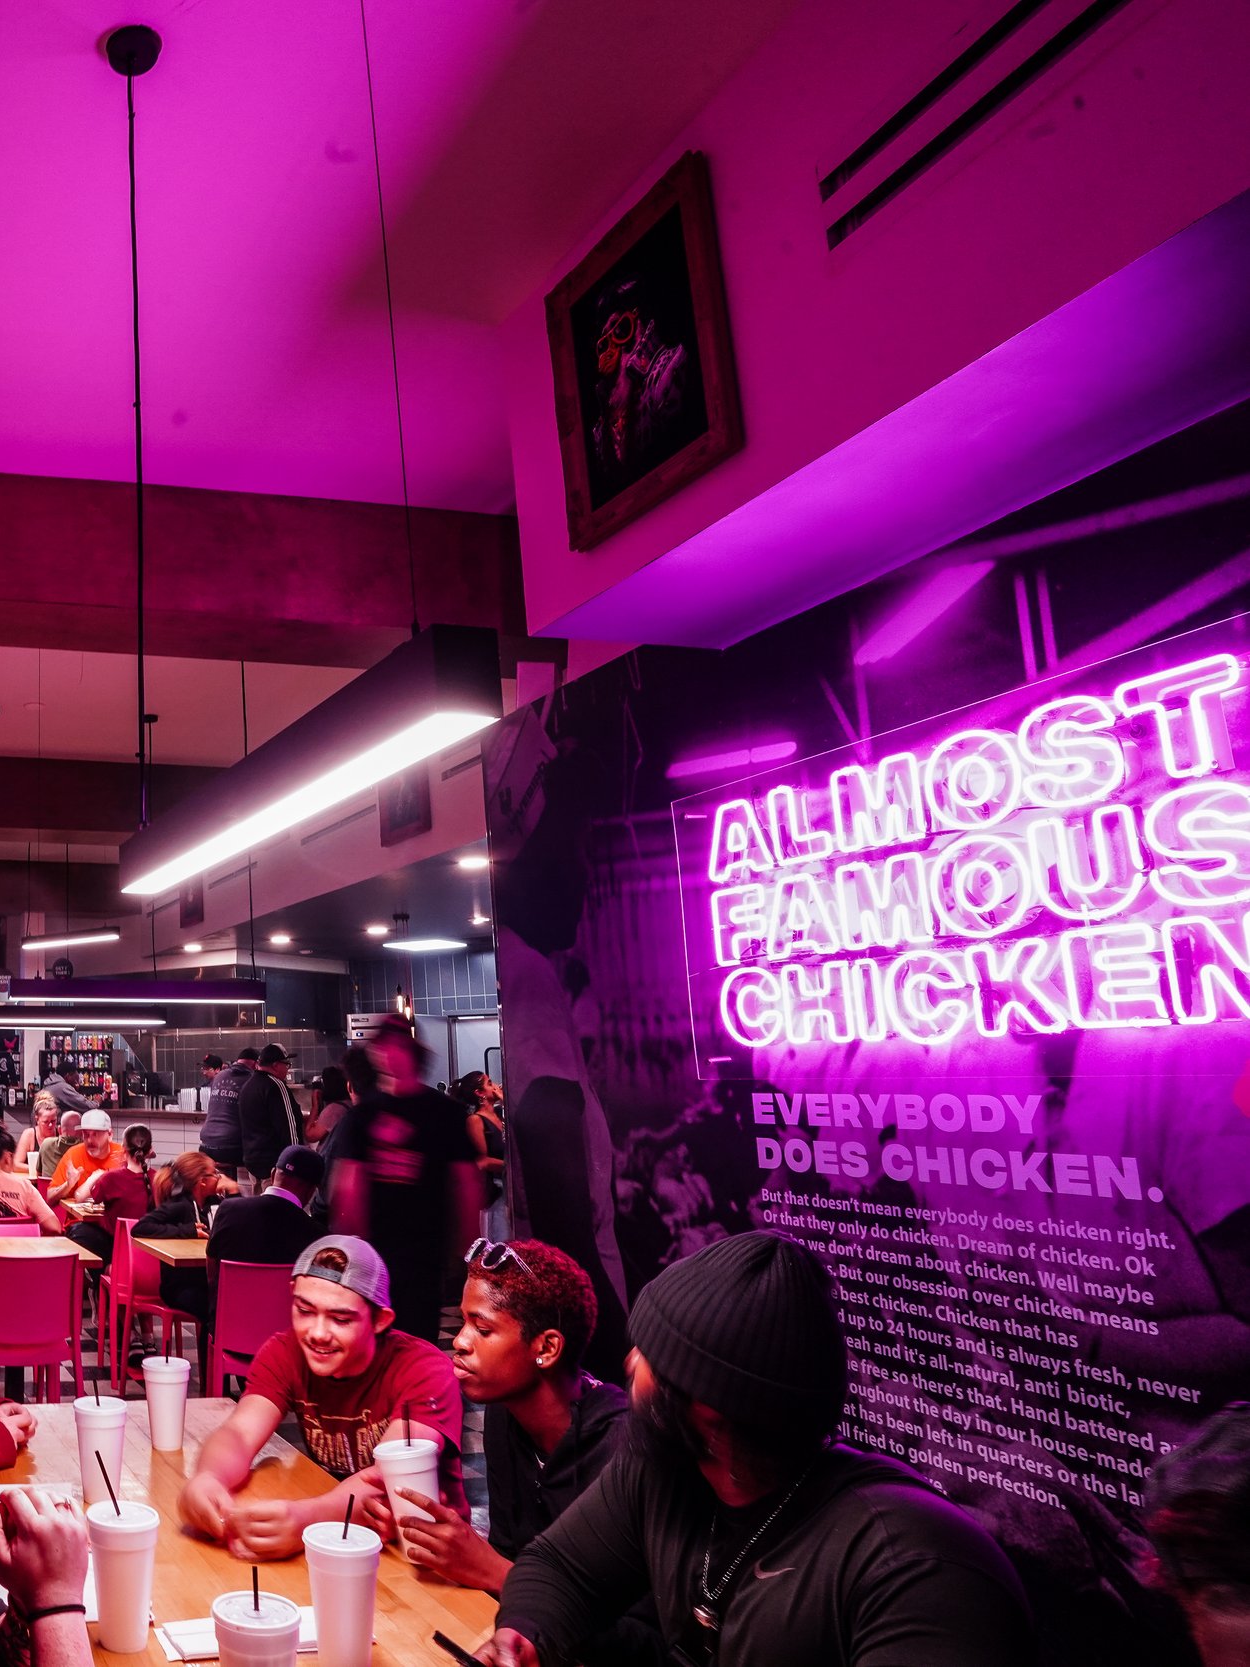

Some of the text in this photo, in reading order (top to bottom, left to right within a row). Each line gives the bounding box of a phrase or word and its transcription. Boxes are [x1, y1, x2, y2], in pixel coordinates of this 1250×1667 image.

[708, 652, 1240, 884] ALMOST
[710, 780, 1250, 967] FAMOUS
[719, 910, 1250, 1048] CHICKEN
[751, 1092, 1043, 1135] EVERYBODY
[756, 1136, 1165, 1204] DOES CHICKEN.
[761, 1188, 782, 1203] But
[784, 1190, 810, 1207] that
[862, 1202, 902, 1218] mean
[904, 1206, 989, 1232] everybody
[992, 1212, 1035, 1233] does
[1038, 1218, 1112, 1242] chicken
[1117, 1226, 1176, 1251] right.
[763, 1209, 1157, 1277] Or that they only do chicken. Dream of chicken. Ok
[807, 1239, 826, 1253] we
[865, 1246, 912, 1267] dream
[915, 1253, 962, 1275] about
[964, 1259, 1036, 1287] chicken.
[1037, 1270, 1079, 1294] Well
[1084, 1281, 1155, 1306] maybe
[839, 1264, 864, 1282] But
[865, 1270, 890, 1287] our
[892, 1276, 969, 1301] obsession
[972, 1290, 1010, 1308] over
[1014, 1294, 1086, 1323] chicken
[1089, 1310, 1159, 1336] means
[840, 1285, 870, 1306] best
[872, 1293, 932, 1319] chicken.
[935, 1305, 1000, 1332] Chicken
[1003, 1318, 1041, 1341] that
[1045, 1325, 1079, 1348] has
[848, 1314, 866, 1331] up
[868, 1317, 884, 1332] to
[886, 1319, 905, 1336] 24
[907, 1323, 952, 1347] hours
[955, 1336, 987, 1355] and
[990, 1341, 1005, 1359] is
[1008, 1346, 1071, 1375] always
[1074, 1358, 1132, 1390] fresh,
[1137, 1376, 1201, 1404] never
[844, 1335, 1131, 1419] eah and it's all-natural, anti biotic,
[860, 1360, 889, 1379] free
[892, 1369, 909, 1385] so
[966, 1387, 1008, 1411] that.
[1011, 1398, 1061, 1426] Hand
[1064, 1410, 1155, 1452] battered
[850, 1382, 911, 1410] oughout
[913, 1394, 940, 1418] the
[942, 1404, 972, 1431] day
[975, 1413, 993, 1434] in
[995, 1421, 1026, 1443] our
[1030, 1428, 1152, 1479] house-made
[852, 1425, 886, 1450] fried
[888, 1438, 905, 1456] to
[907, 1447, 964, 1476] golden
[966, 1465, 1067, 1511] perfection.
[859, 1404, 884, 1426] has
[886, 1411, 924, 1438] been
[926, 1424, 954, 1449] left
[957, 1433, 974, 1454] in
[977, 1442, 1054, 1479] quarters
[1057, 1468, 1079, 1486] or
[1081, 1473, 1118, 1499] the
